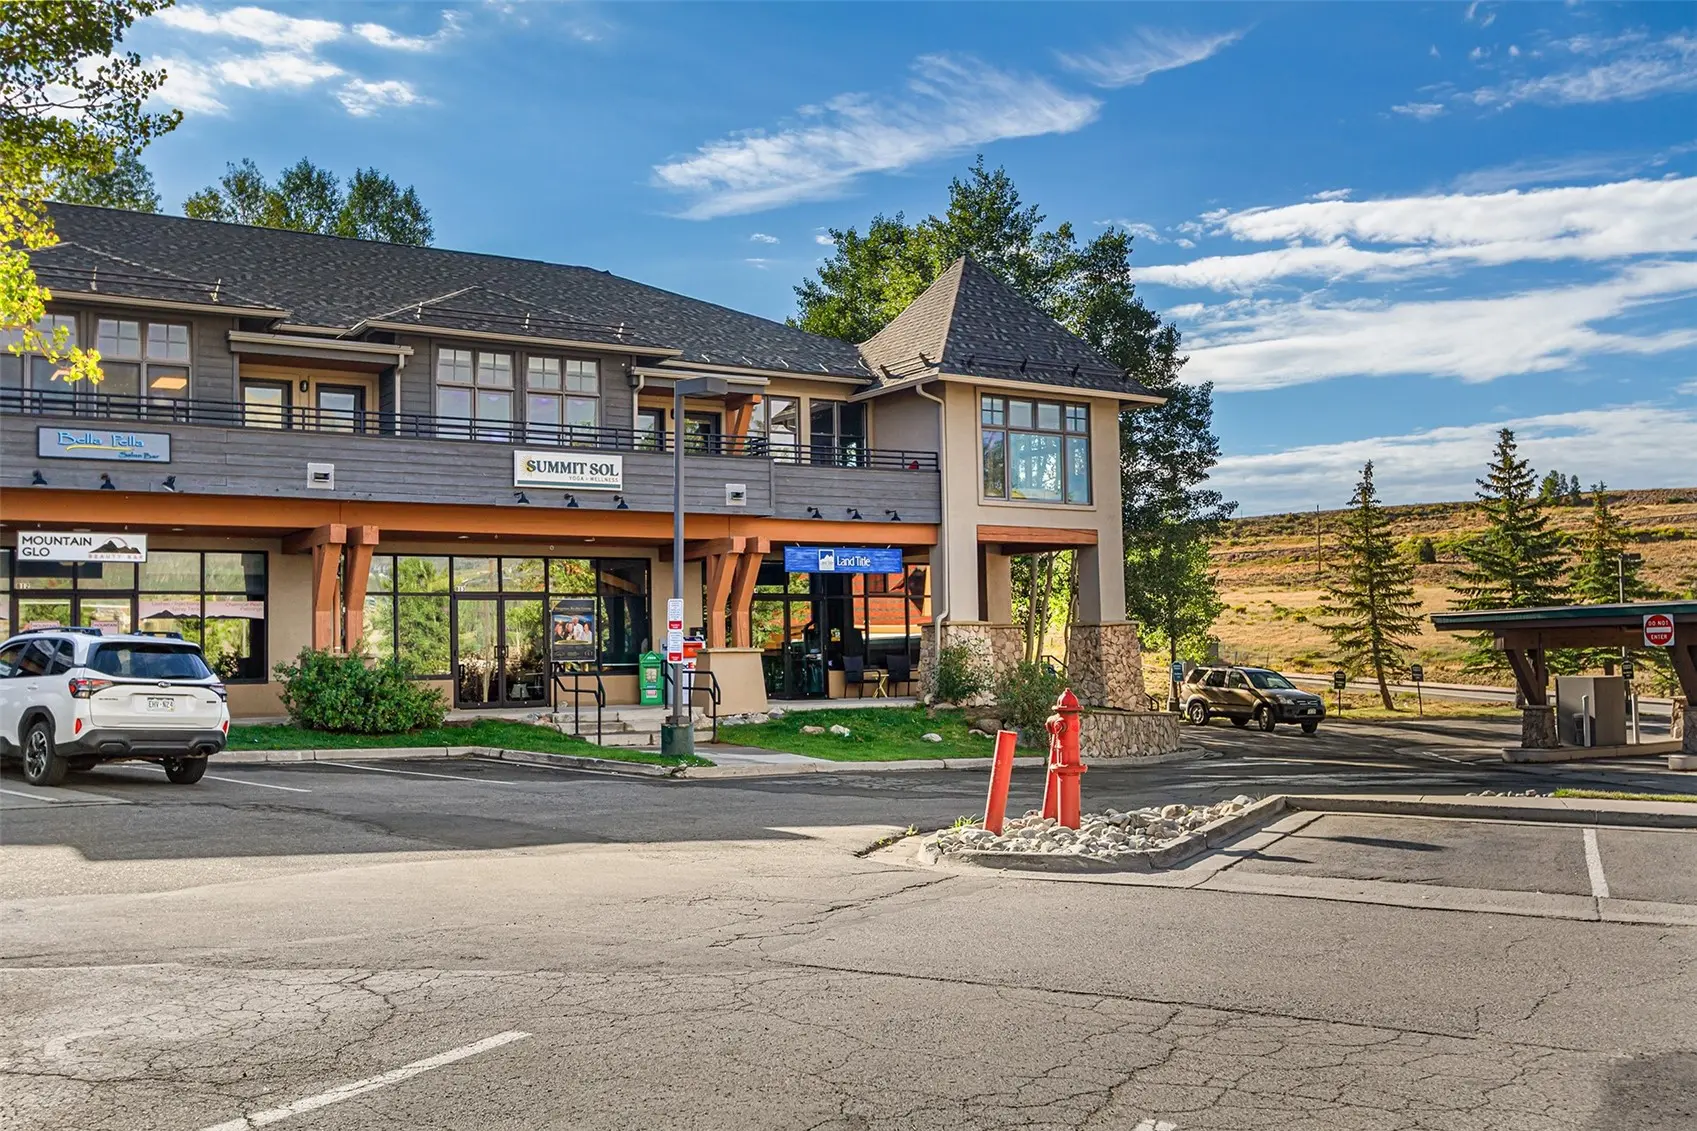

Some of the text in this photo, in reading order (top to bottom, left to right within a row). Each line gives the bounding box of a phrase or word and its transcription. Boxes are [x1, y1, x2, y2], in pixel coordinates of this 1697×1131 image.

[57, 431, 103, 446] Bella
[526, 459, 619, 477] SUMMIT SOL
[21, 535, 92, 557] MOUNTAIN GLO
[836, 556, 855, 567] Land
[856, 556, 871, 567] Title
